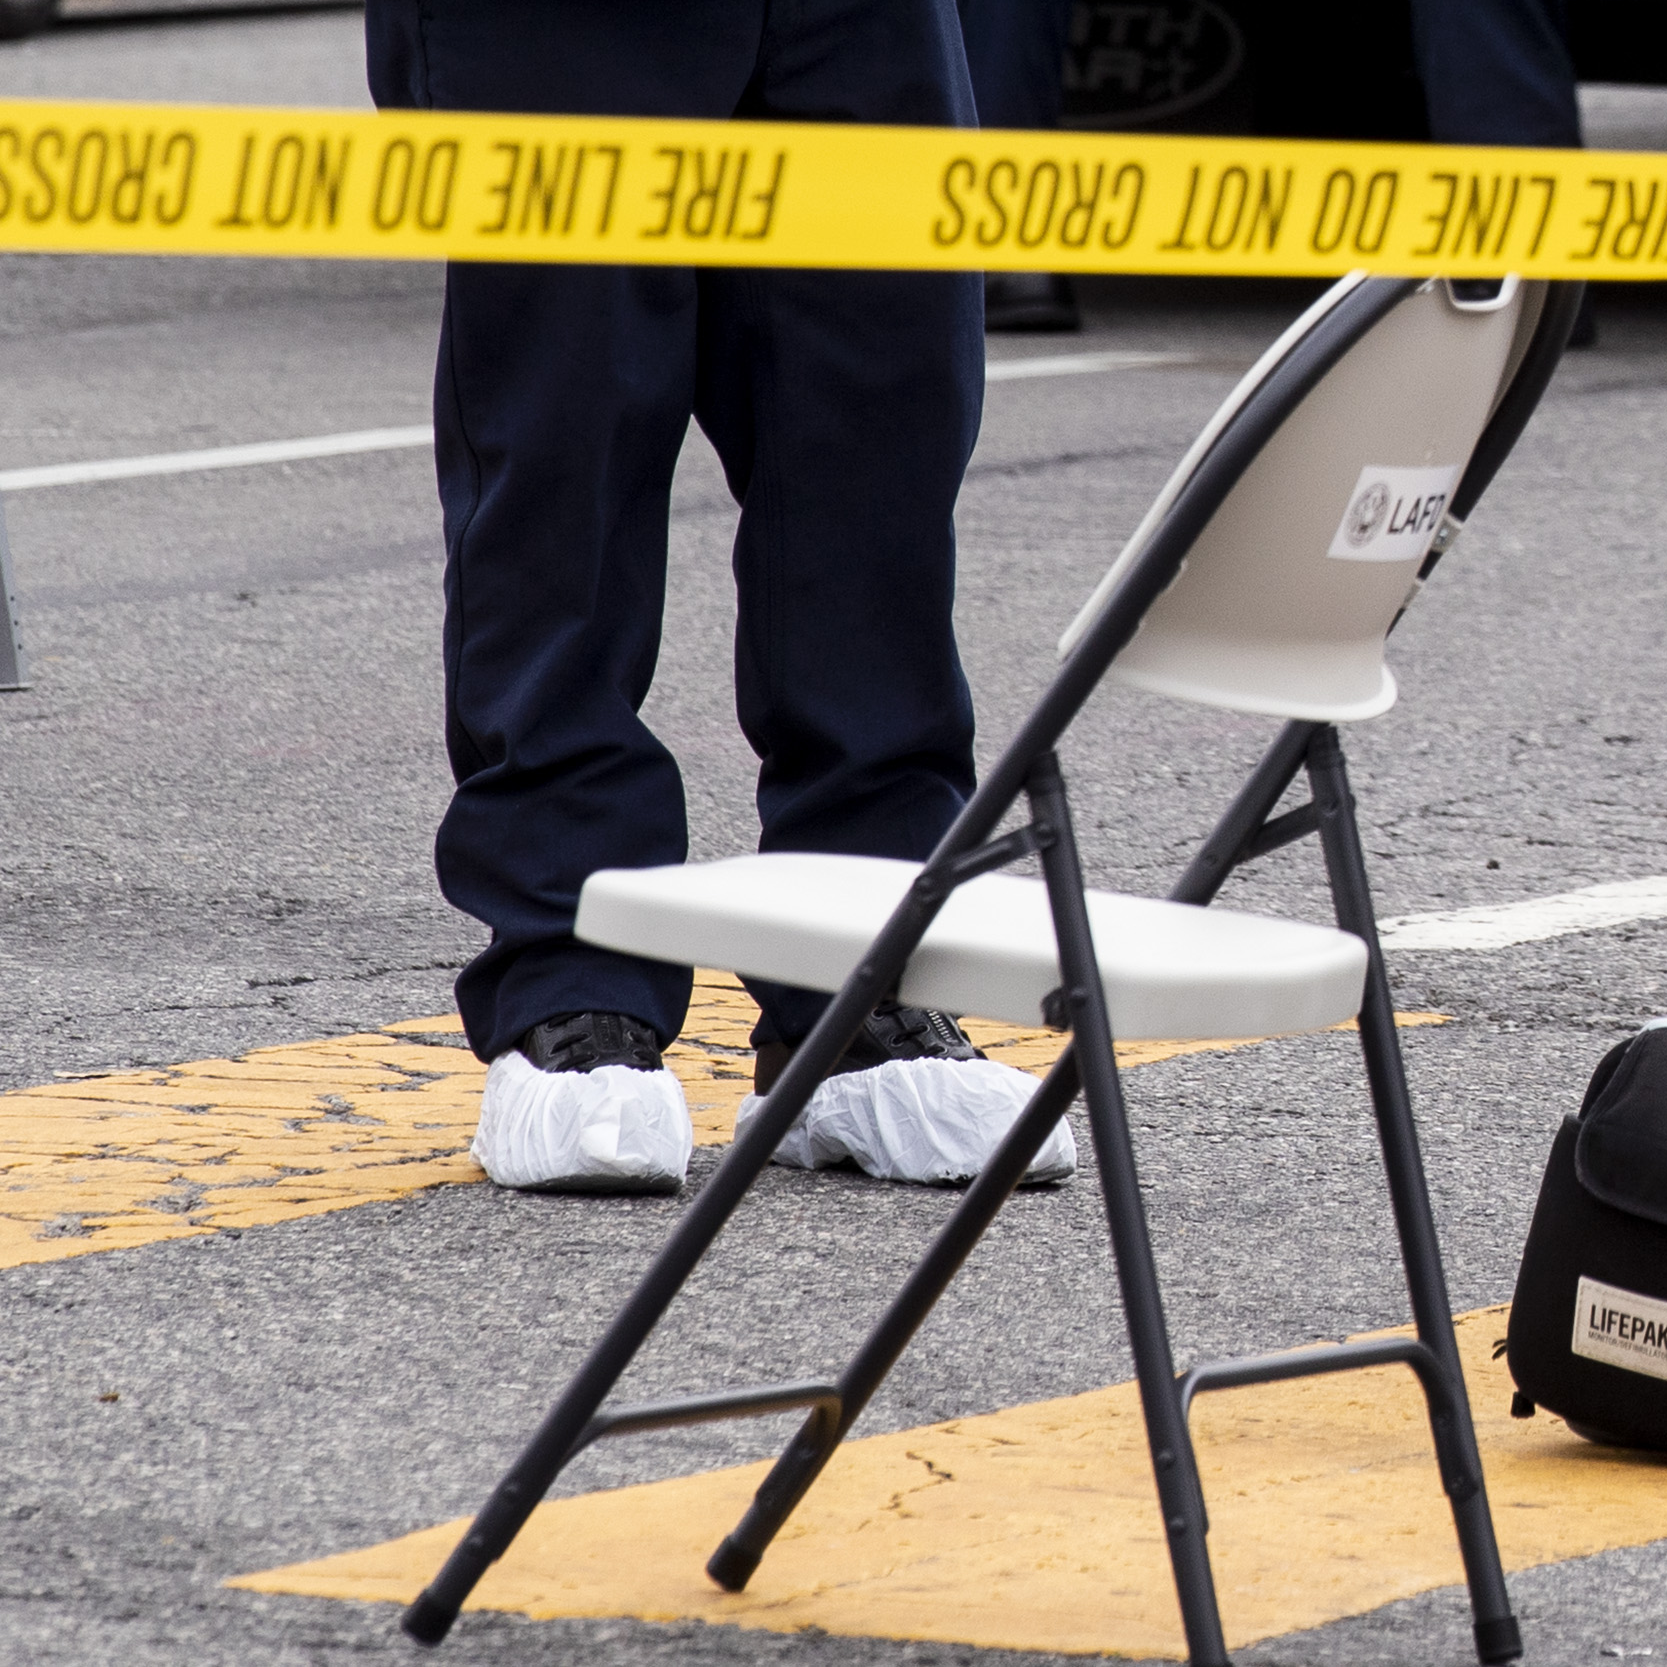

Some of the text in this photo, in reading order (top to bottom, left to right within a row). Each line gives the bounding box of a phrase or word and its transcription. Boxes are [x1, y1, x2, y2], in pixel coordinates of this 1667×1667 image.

[212, 127, 351, 230] NOT
[372, 135, 464, 233] DO
[475, 138, 624, 238] LINE
[640, 144, 789, 241] FIRE
[930, 154, 1147, 251] CROSS
[1154, 161, 1295, 252] NOT
[1307, 166, 1399, 254] DO
[1408, 169, 1560, 258] LINE
[1385, 493, 1447, 535] LAFD
